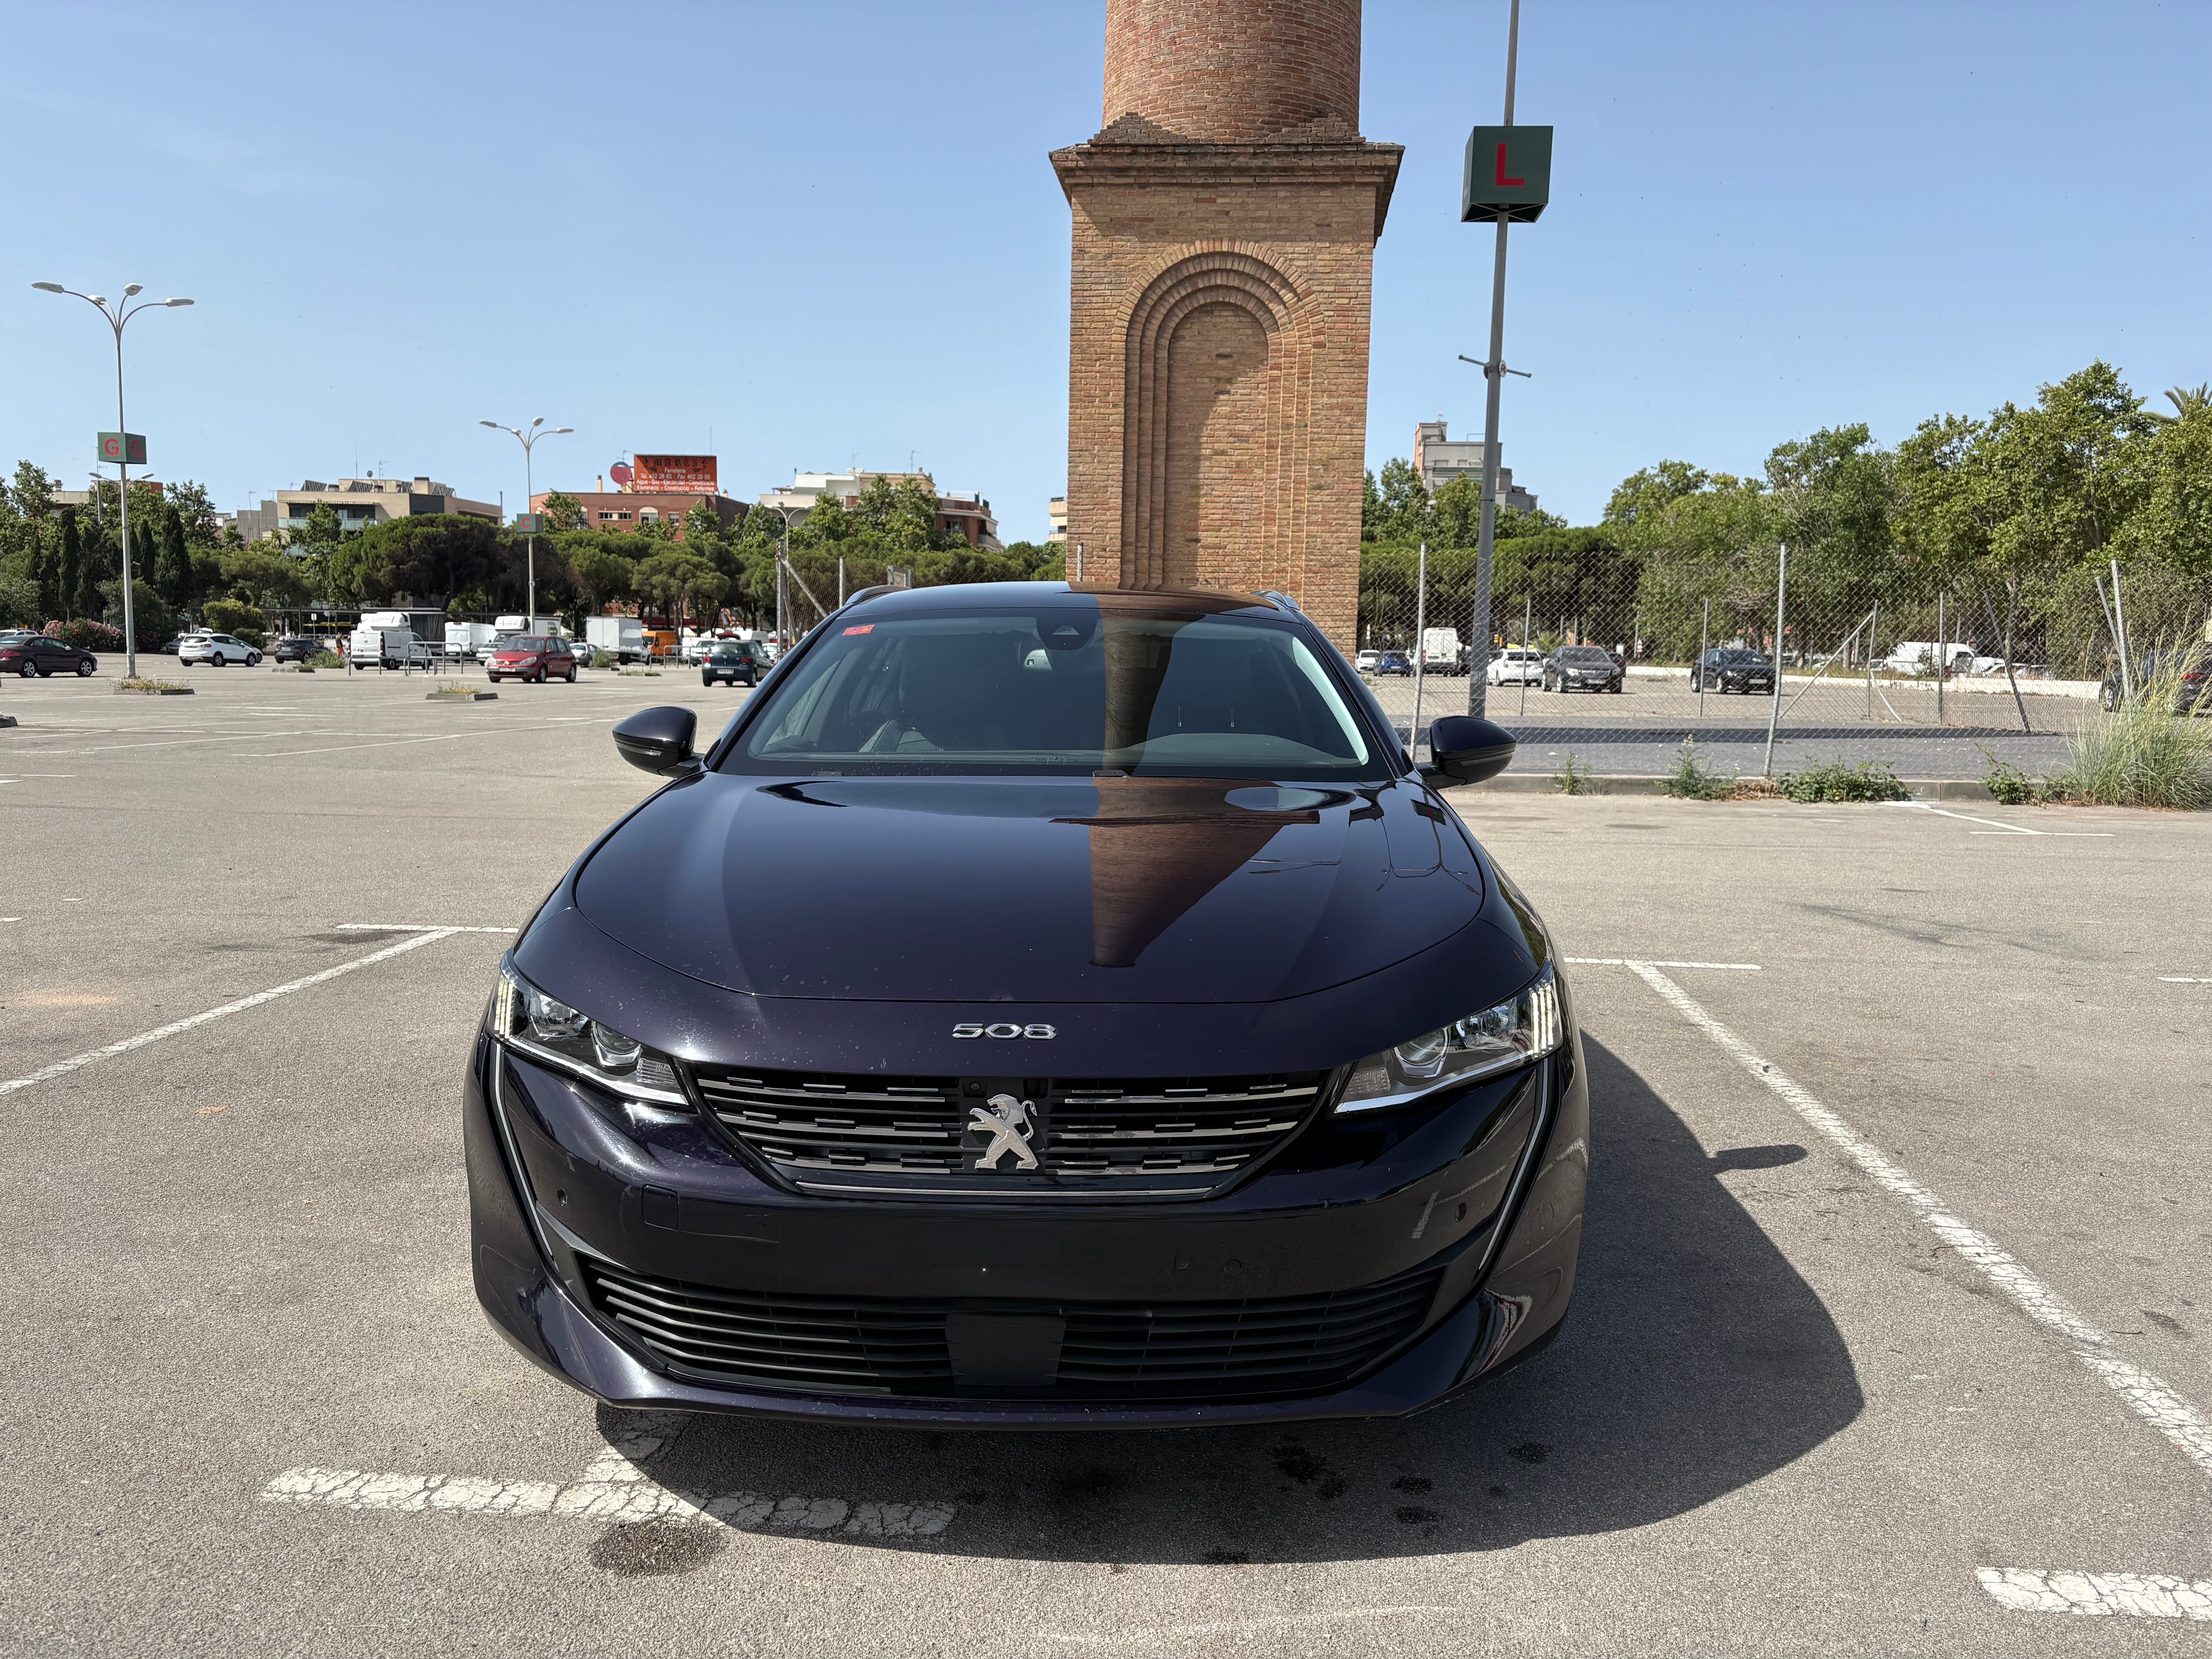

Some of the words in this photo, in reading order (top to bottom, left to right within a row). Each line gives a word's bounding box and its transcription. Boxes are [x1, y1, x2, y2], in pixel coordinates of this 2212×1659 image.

[1496, 143, 1526, 186] L
[105, 438, 120, 456] G
[131, 440, 143, 458] G
[522, 517, 531, 529] C
[952, 1023, 1056, 1040] 508
